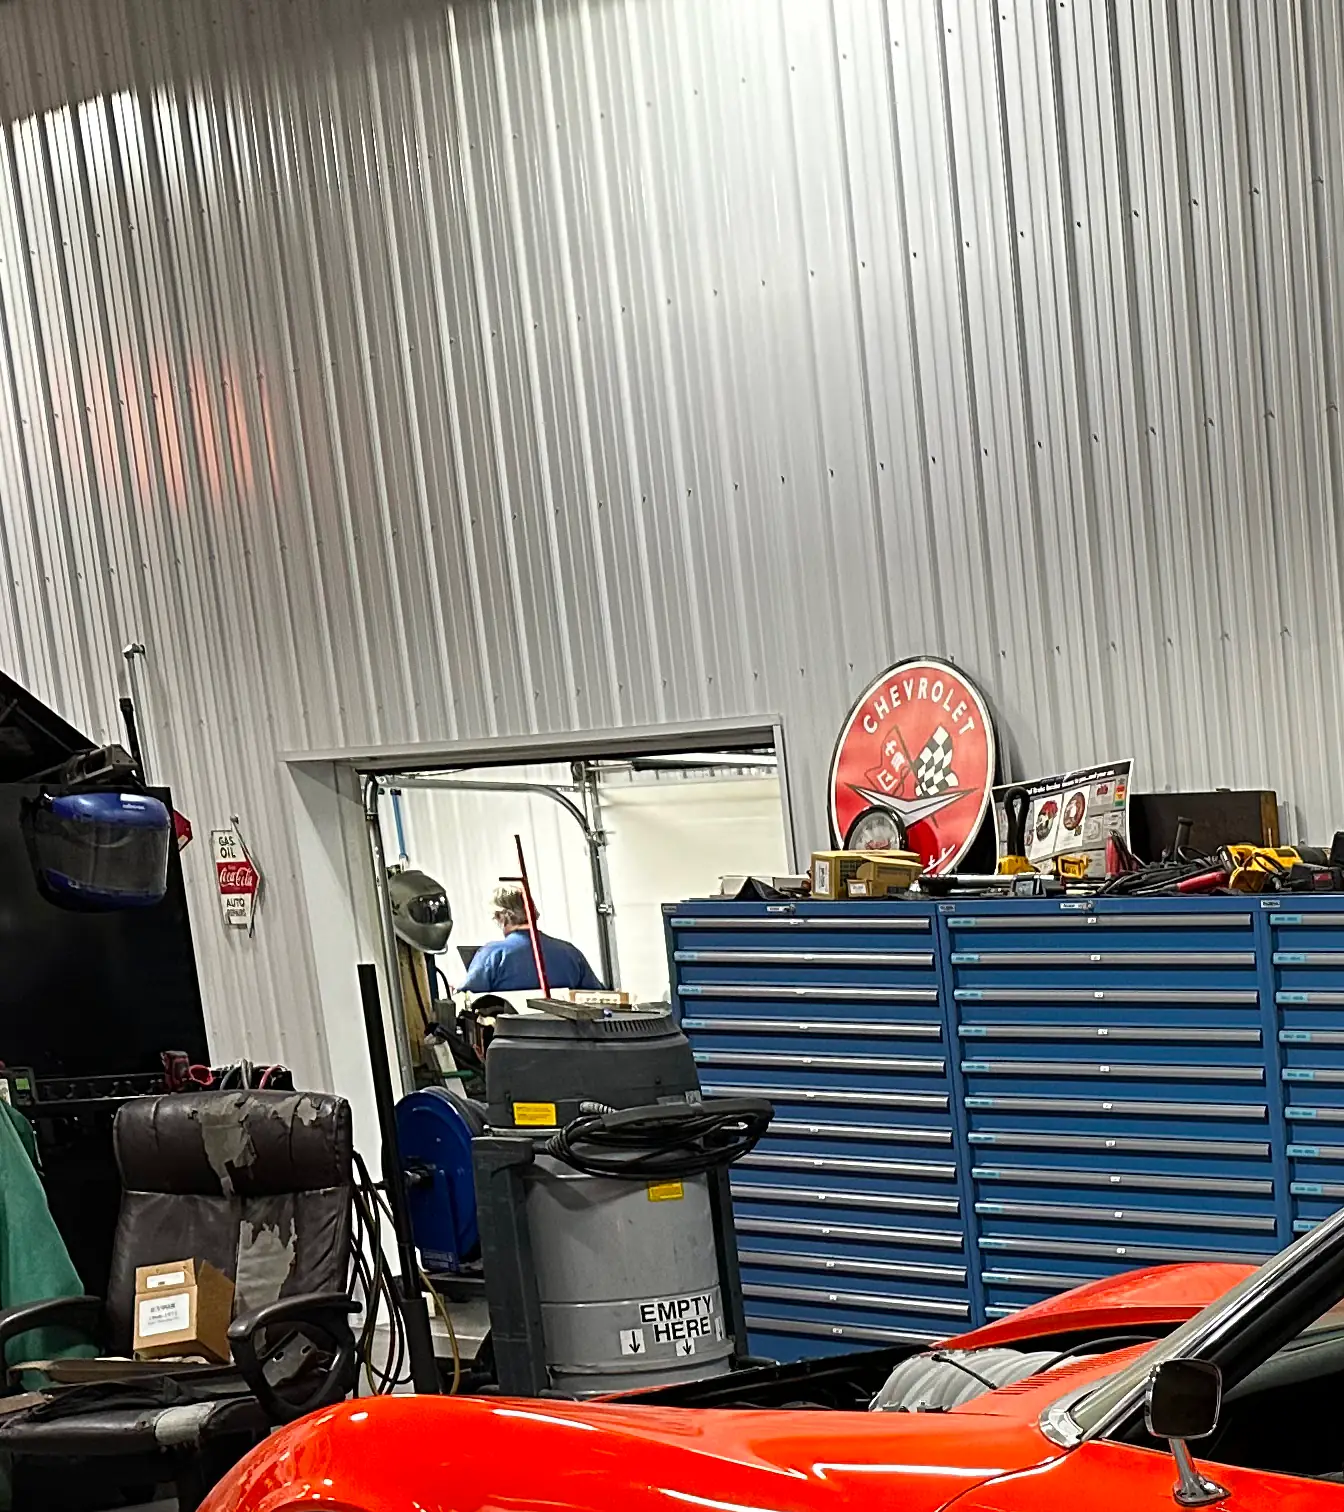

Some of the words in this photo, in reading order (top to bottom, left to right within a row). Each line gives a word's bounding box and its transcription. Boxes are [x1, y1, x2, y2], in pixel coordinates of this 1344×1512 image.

[863, 677, 976, 735] CHEVROLET
[218, 835, 236, 846] GAS
[220, 847, 236, 858] OIL
[226, 898, 245, 907] AUTO
[640, 1294, 712, 1323] EMPTY
[653, 1316, 711, 1343] HERE
